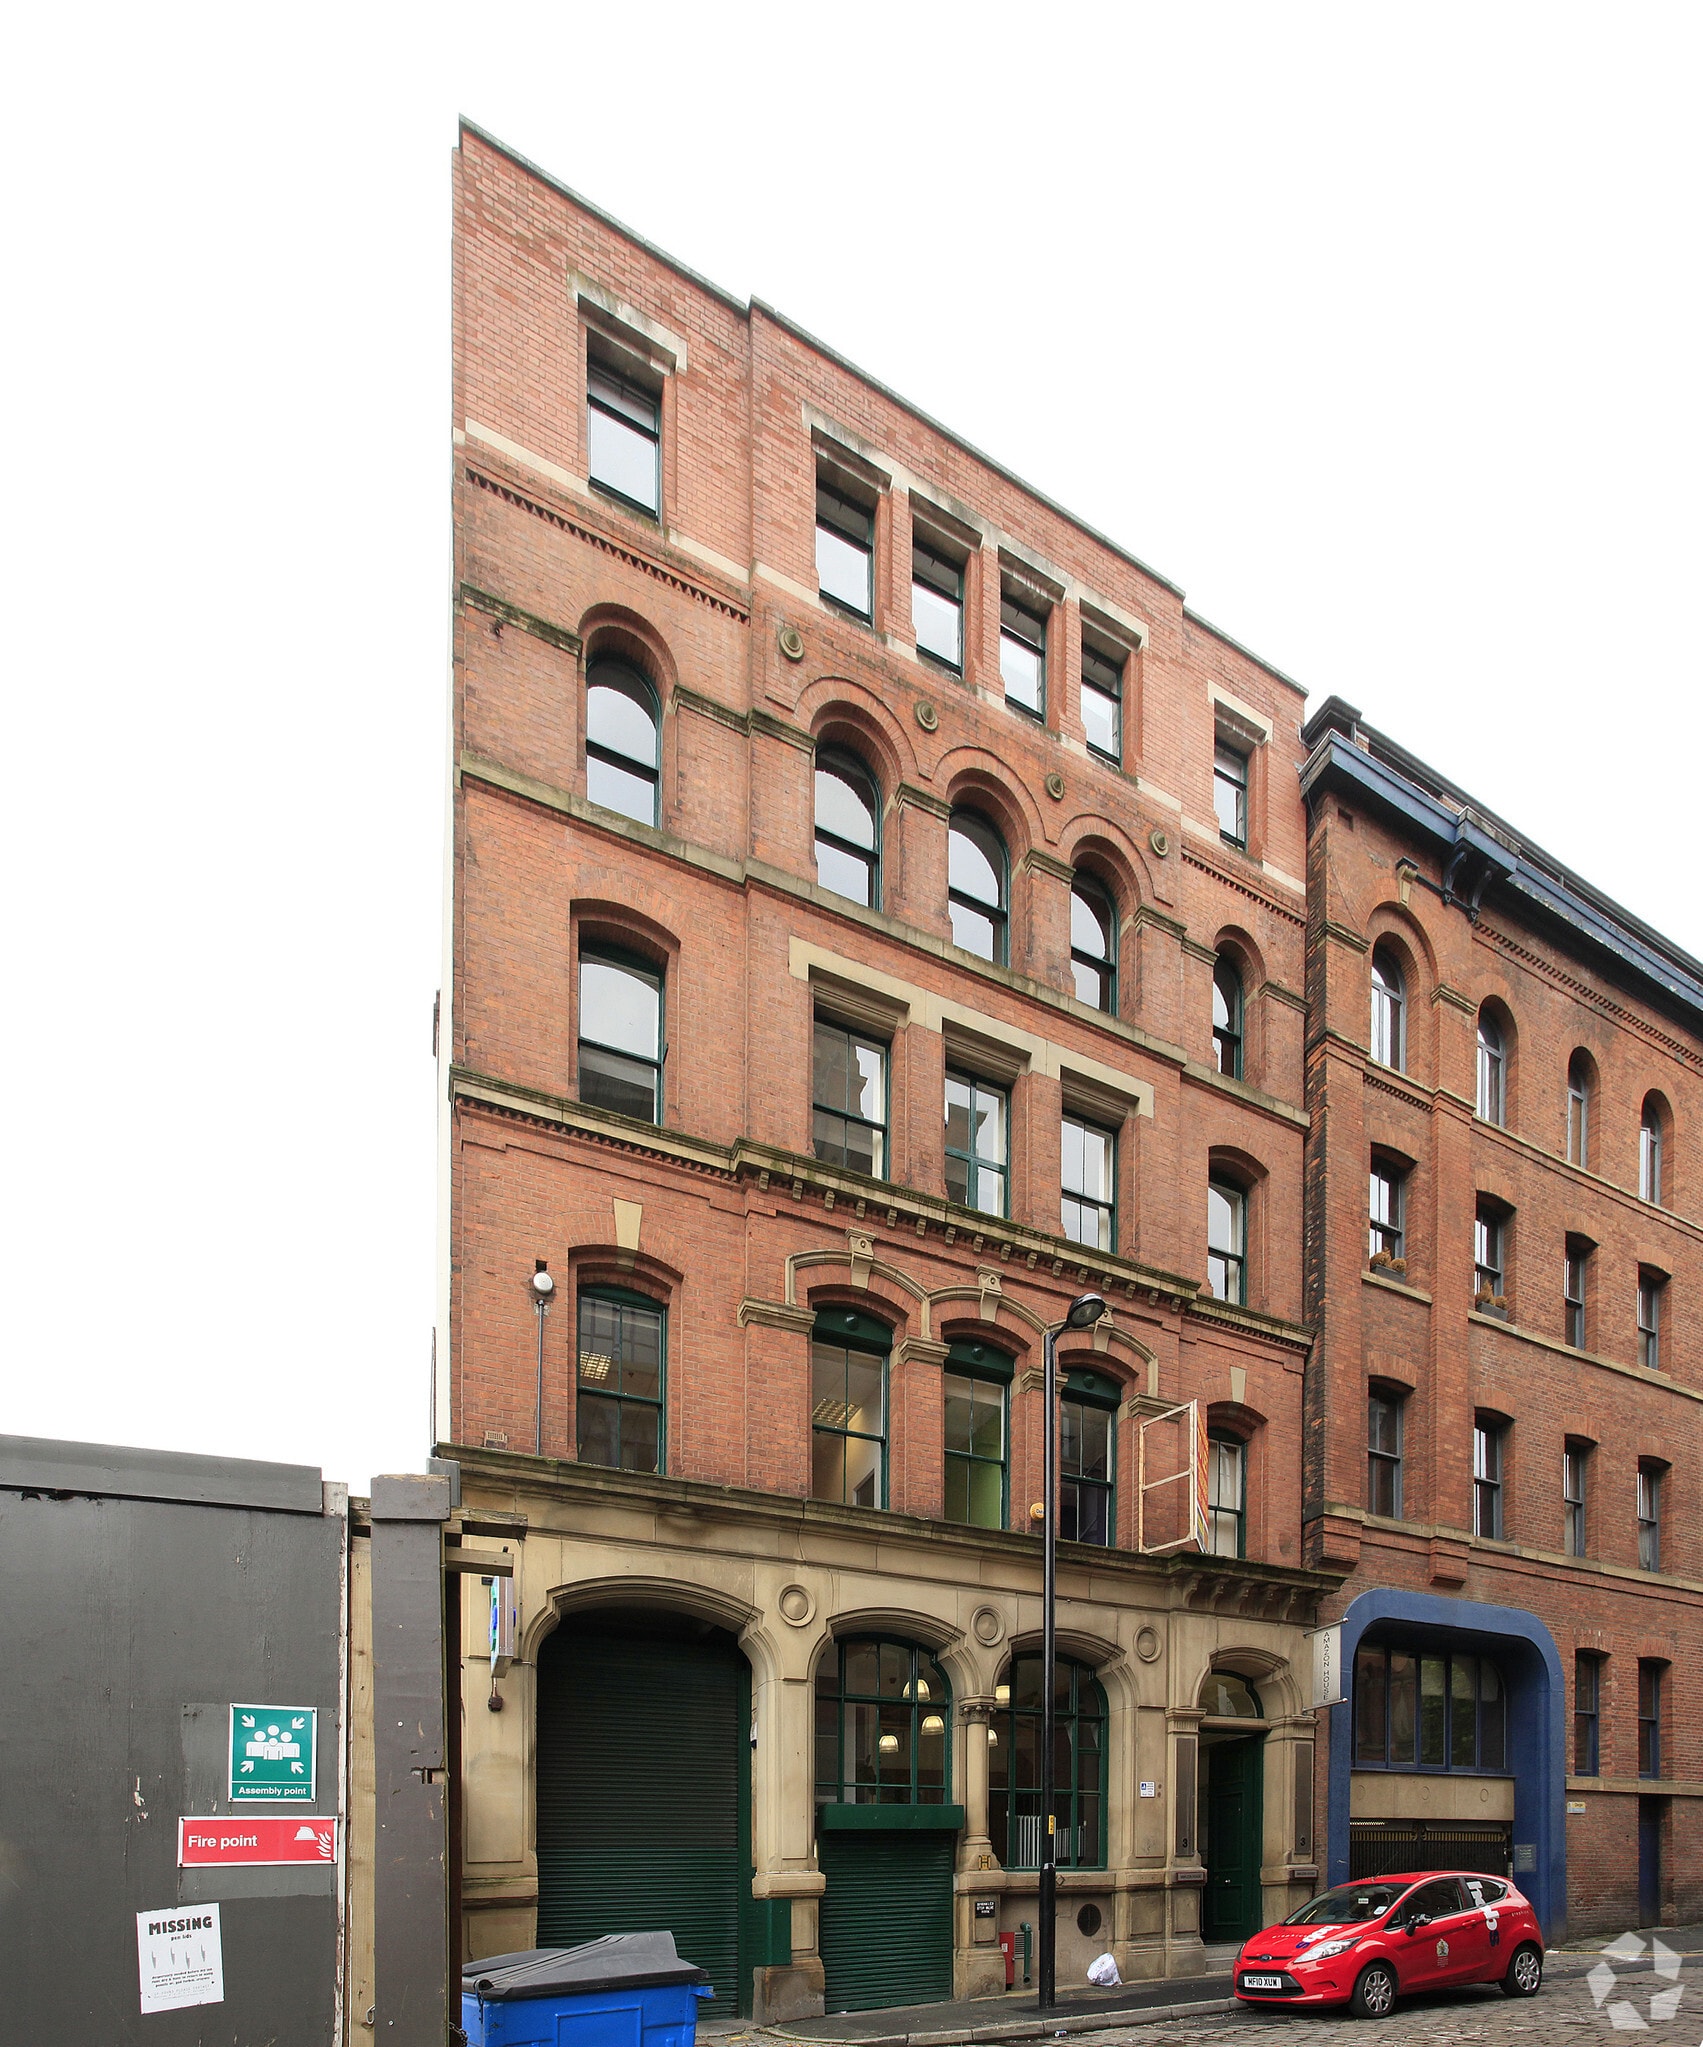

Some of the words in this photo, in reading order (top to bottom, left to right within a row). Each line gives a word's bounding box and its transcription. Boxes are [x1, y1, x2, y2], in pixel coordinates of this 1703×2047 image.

[238, 1786, 281, 1796] Assembly
[284, 1787, 307, 1796] point
[188, 1835, 217, 1847] Fire
[220, 1835, 258, 1850] point
[1182, 1838, 1188, 1848] 3
[1300, 1837, 1306, 1846] 3
[148, 1915, 213, 1936] MISSING
